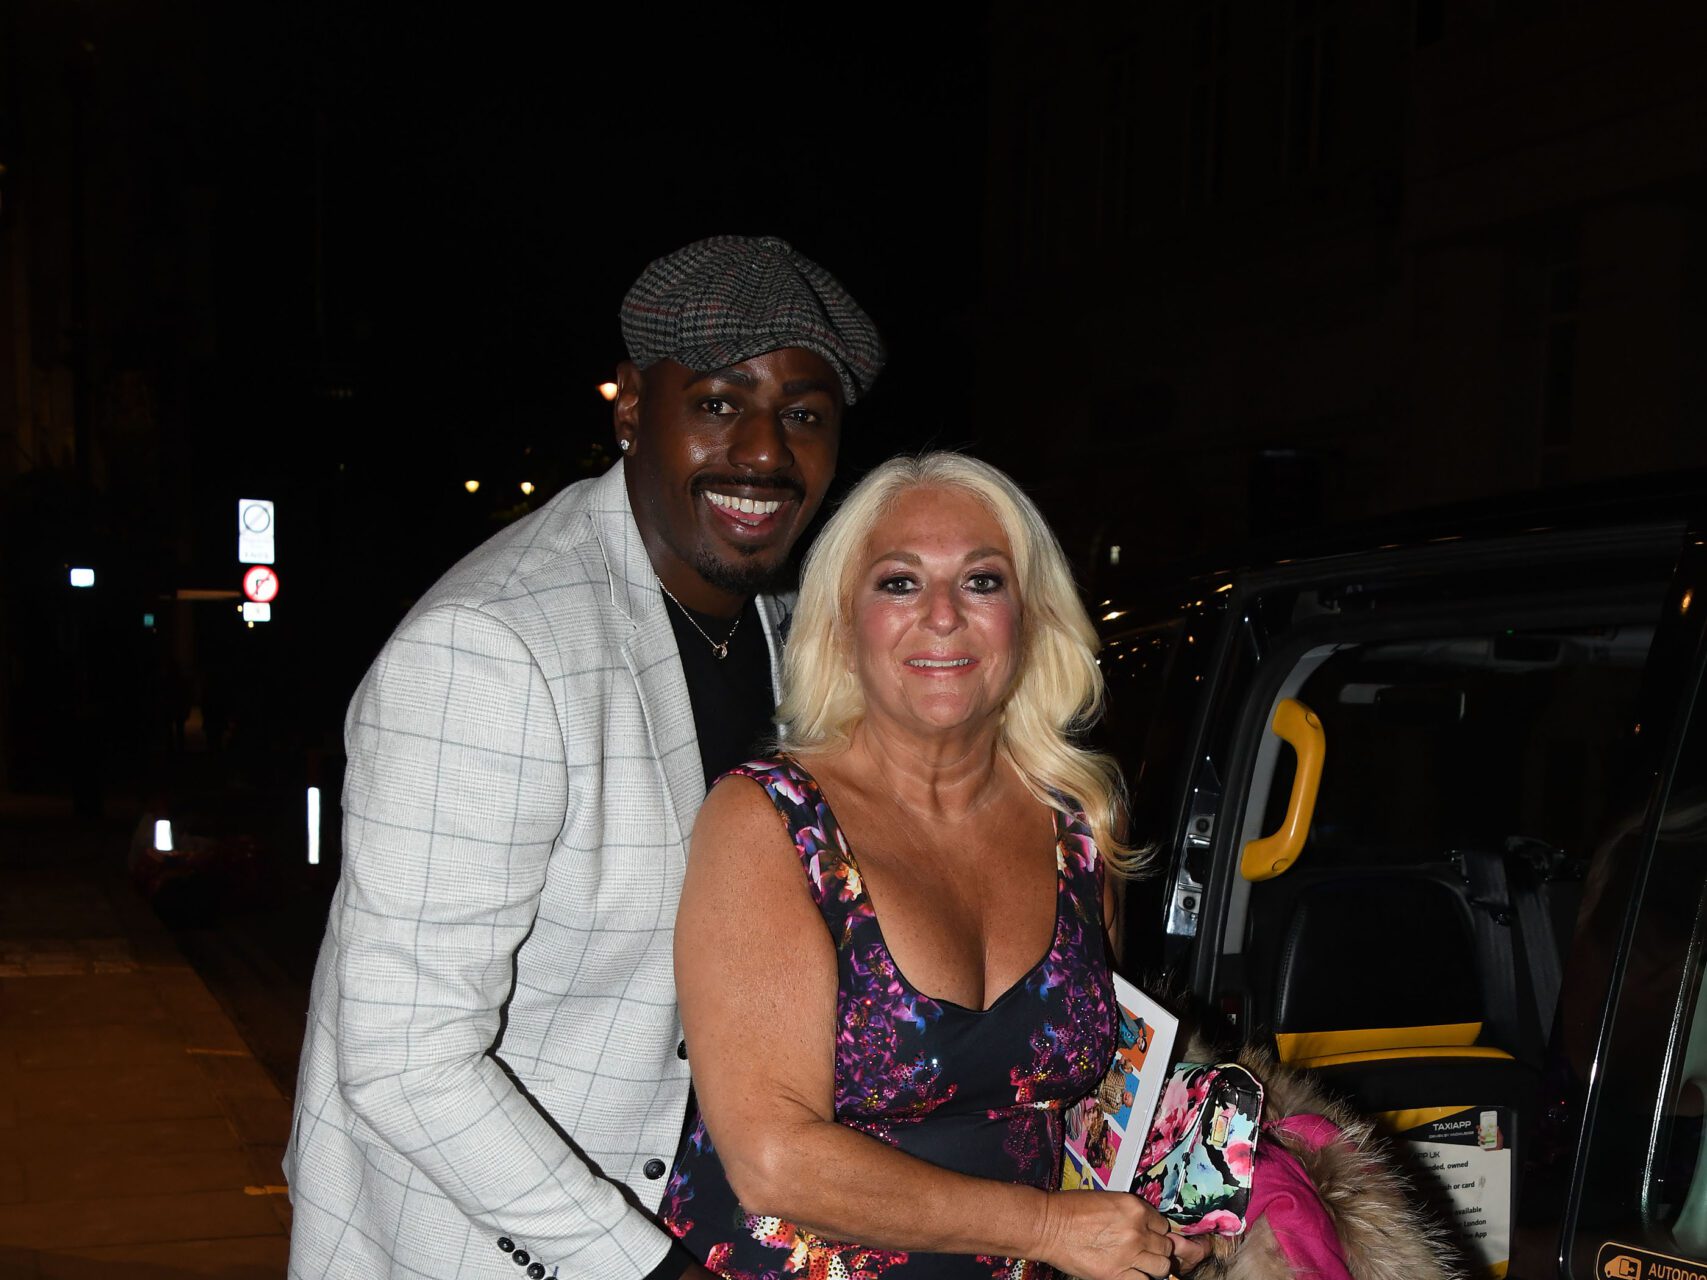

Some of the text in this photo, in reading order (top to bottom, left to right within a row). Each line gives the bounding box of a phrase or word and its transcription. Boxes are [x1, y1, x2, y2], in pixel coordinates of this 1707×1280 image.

[1433, 1120, 1472, 1131] TAXIAPP
[1447, 1161, 1468, 1169] owned
[1453, 1182, 1460, 1190] or
[1461, 1181, 1475, 1189] card
[1455, 1206, 1482, 1216] available
[1463, 1218, 1487, 1227] London
[1475, 1231, 1488, 1240] App
